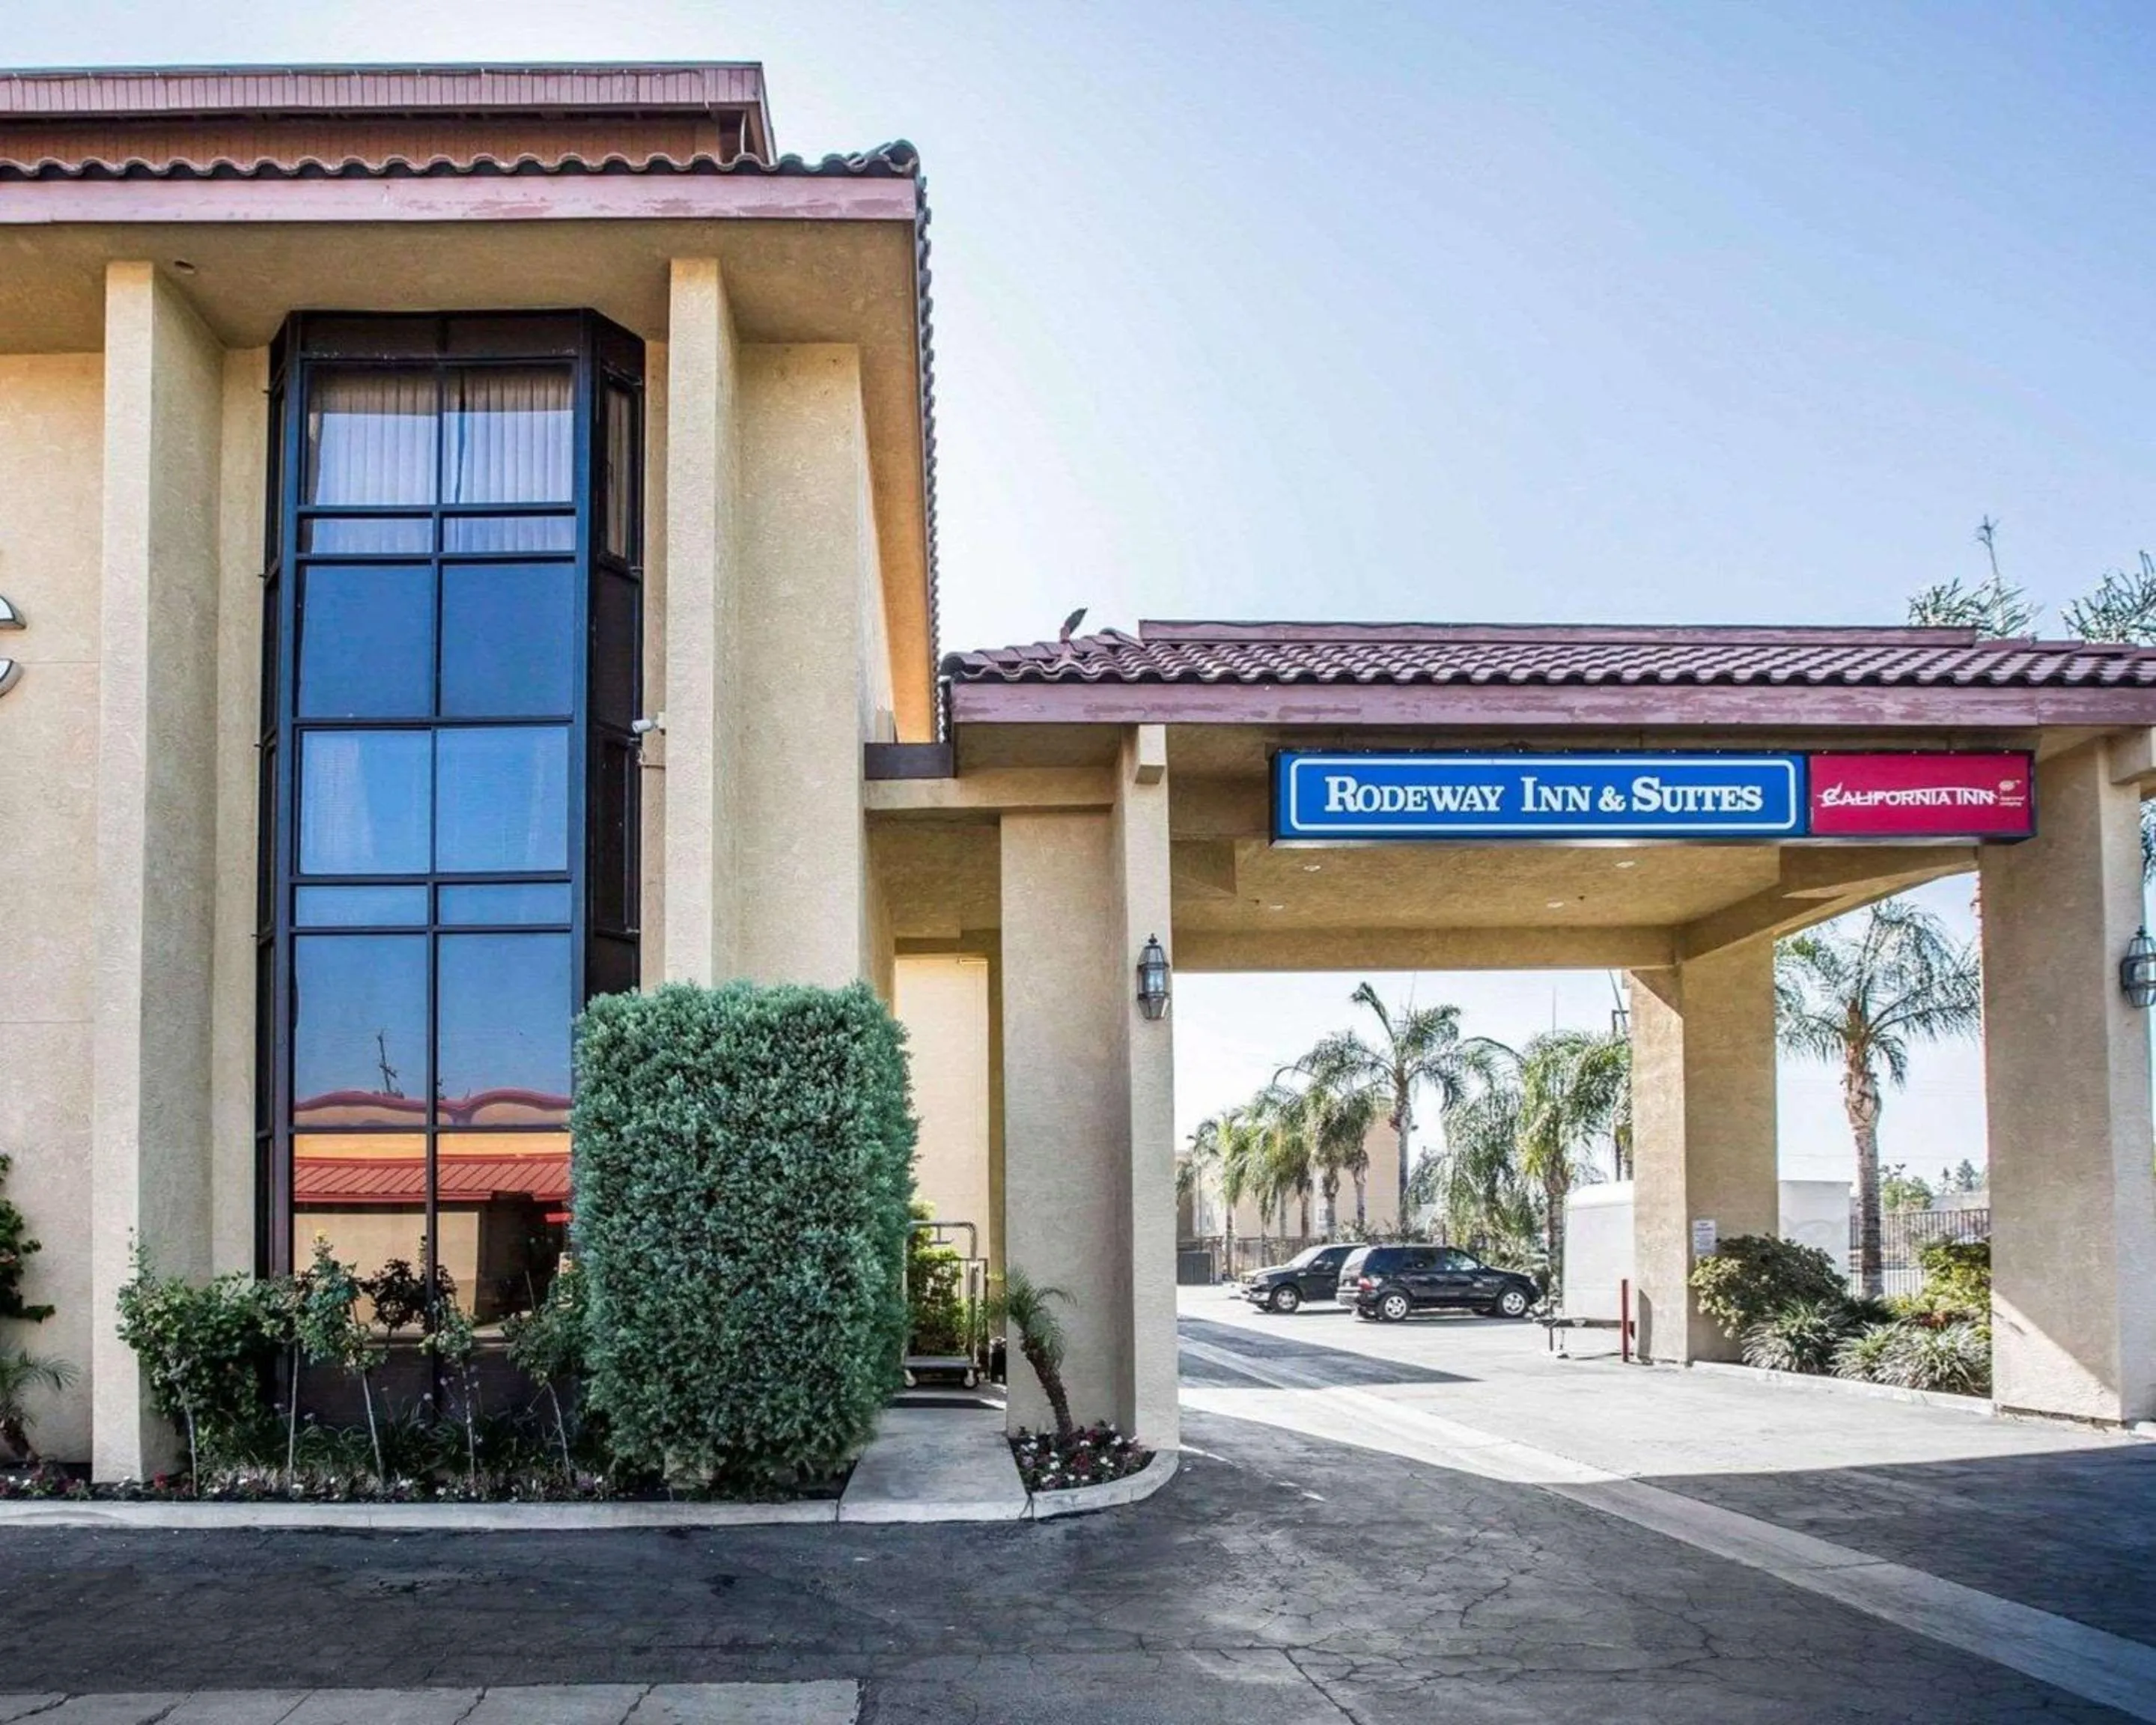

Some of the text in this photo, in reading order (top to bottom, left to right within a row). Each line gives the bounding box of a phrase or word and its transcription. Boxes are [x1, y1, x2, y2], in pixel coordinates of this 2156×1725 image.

[1324, 776, 1763, 812] RODEWAY INN & SUITES
[1817, 782, 1950, 807] CALIFORNIA
[1955, 788, 1996, 806] INN
